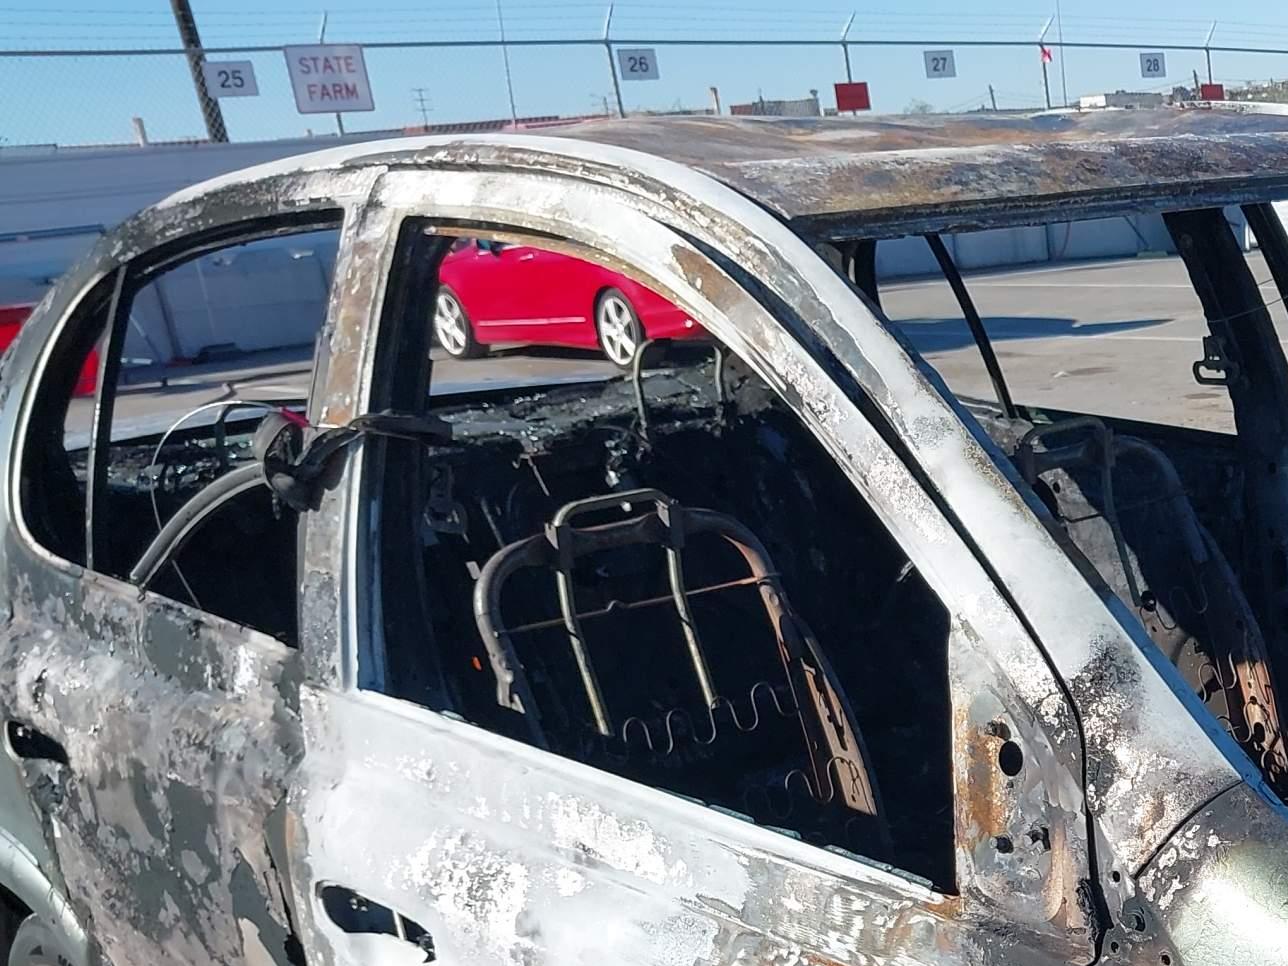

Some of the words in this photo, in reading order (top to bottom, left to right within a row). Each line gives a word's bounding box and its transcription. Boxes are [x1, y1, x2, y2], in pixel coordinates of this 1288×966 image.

[299, 55, 356, 75] STATE
[628, 56, 649, 72] 26
[932, 57, 947, 72] 27
[1145, 58, 1160, 72] 28
[217, 70, 245, 88] 25
[306, 83, 360, 101] FARM
